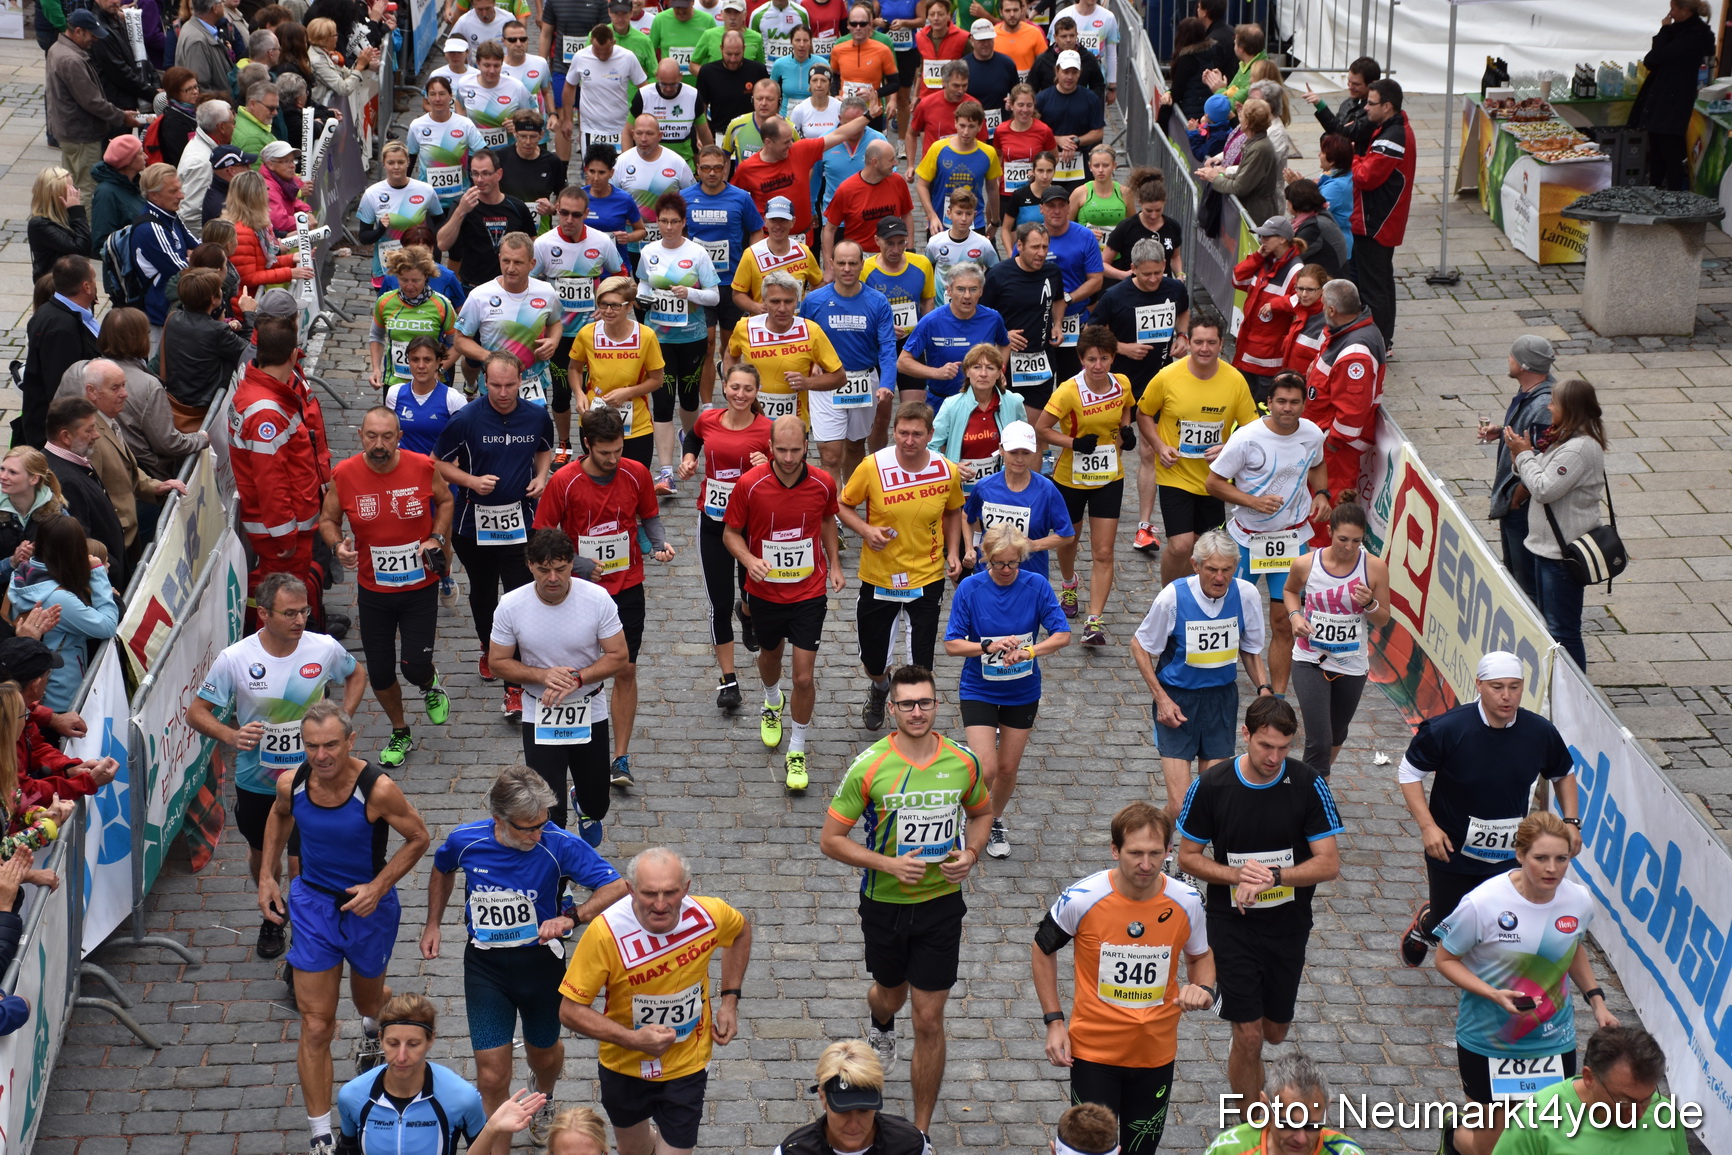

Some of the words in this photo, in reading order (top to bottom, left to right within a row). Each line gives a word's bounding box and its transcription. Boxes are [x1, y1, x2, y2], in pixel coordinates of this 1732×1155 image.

[431, 173, 460, 188] 2394
[691, 210, 728, 219] HUBER
[787, 262, 809, 274] BÖGL
[559, 285, 591, 300] 3018
[655, 314, 680, 322] ALEX
[828, 315, 867, 325] HUBER
[1140, 312, 1173, 330] 2173
[387, 319, 433, 332] BOCK
[1148, 330, 1168, 339] Ludwig
[594, 352, 614, 360] MAX
[617, 350, 640, 360] BÖGL
[750, 348, 777, 360] MAX
[781, 344, 812, 356] BÖGL
[1015, 358, 1047, 373] 2209
[836, 378, 869, 394] 2310
[1082, 406, 1103, 417] MAX
[482, 435, 504, 444] EURO
[511, 434, 535, 443] POLES
[1184, 427, 1219, 445] 2180
[1081, 455, 1109, 472] 364
[1081, 473, 1110, 481] Marianne
[883, 491, 916, 505] MAX
[919, 483, 951, 498] BÖGL
[998, 508, 1022, 516] Neumarkt
[480, 512, 520, 530] 2155
[490, 532, 514, 540] Marcus
[1268, 533, 1291, 541] Neumarkt
[595, 545, 616, 560] 15
[1265, 541, 1285, 557] 69
[377, 552, 419, 572] 2211
[773, 550, 804, 568] 157
[1258, 558, 1291, 568] Ferdinand
[391, 574, 409, 582] Josef
[777, 570, 801, 578] Tobias
[1206, 623, 1232, 631] Neumarkt
[1314, 622, 1357, 642] 2054
[1198, 631, 1230, 651] 521
[996, 666, 1022, 675] Monika
[541, 705, 587, 725] 2797
[554, 729, 574, 738] Peter
[882, 789, 962, 811] BOCK
[921, 812, 951, 821] Neumarkt
[904, 818, 953, 843] 2770
[1471, 822, 1491, 830] PARTL
[1477, 850, 1509, 859] Gerhard
[477, 903, 531, 926] 2608
[489, 930, 520, 941] Johann
[1102, 951, 1126, 959] PARTL
[627, 962, 672, 987] MAX
[675, 937, 719, 968] BÖGL
[1114, 961, 1157, 985] 346
[634, 997, 658, 1006] PARTL
[659, 993, 692, 1005] Neumarkt
[1114, 989, 1153, 1000] Matthias
[640, 998, 696, 1025] 2737
[1497, 1055, 1557, 1075] 2822
[1519, 1081, 1536, 1090] Eva
